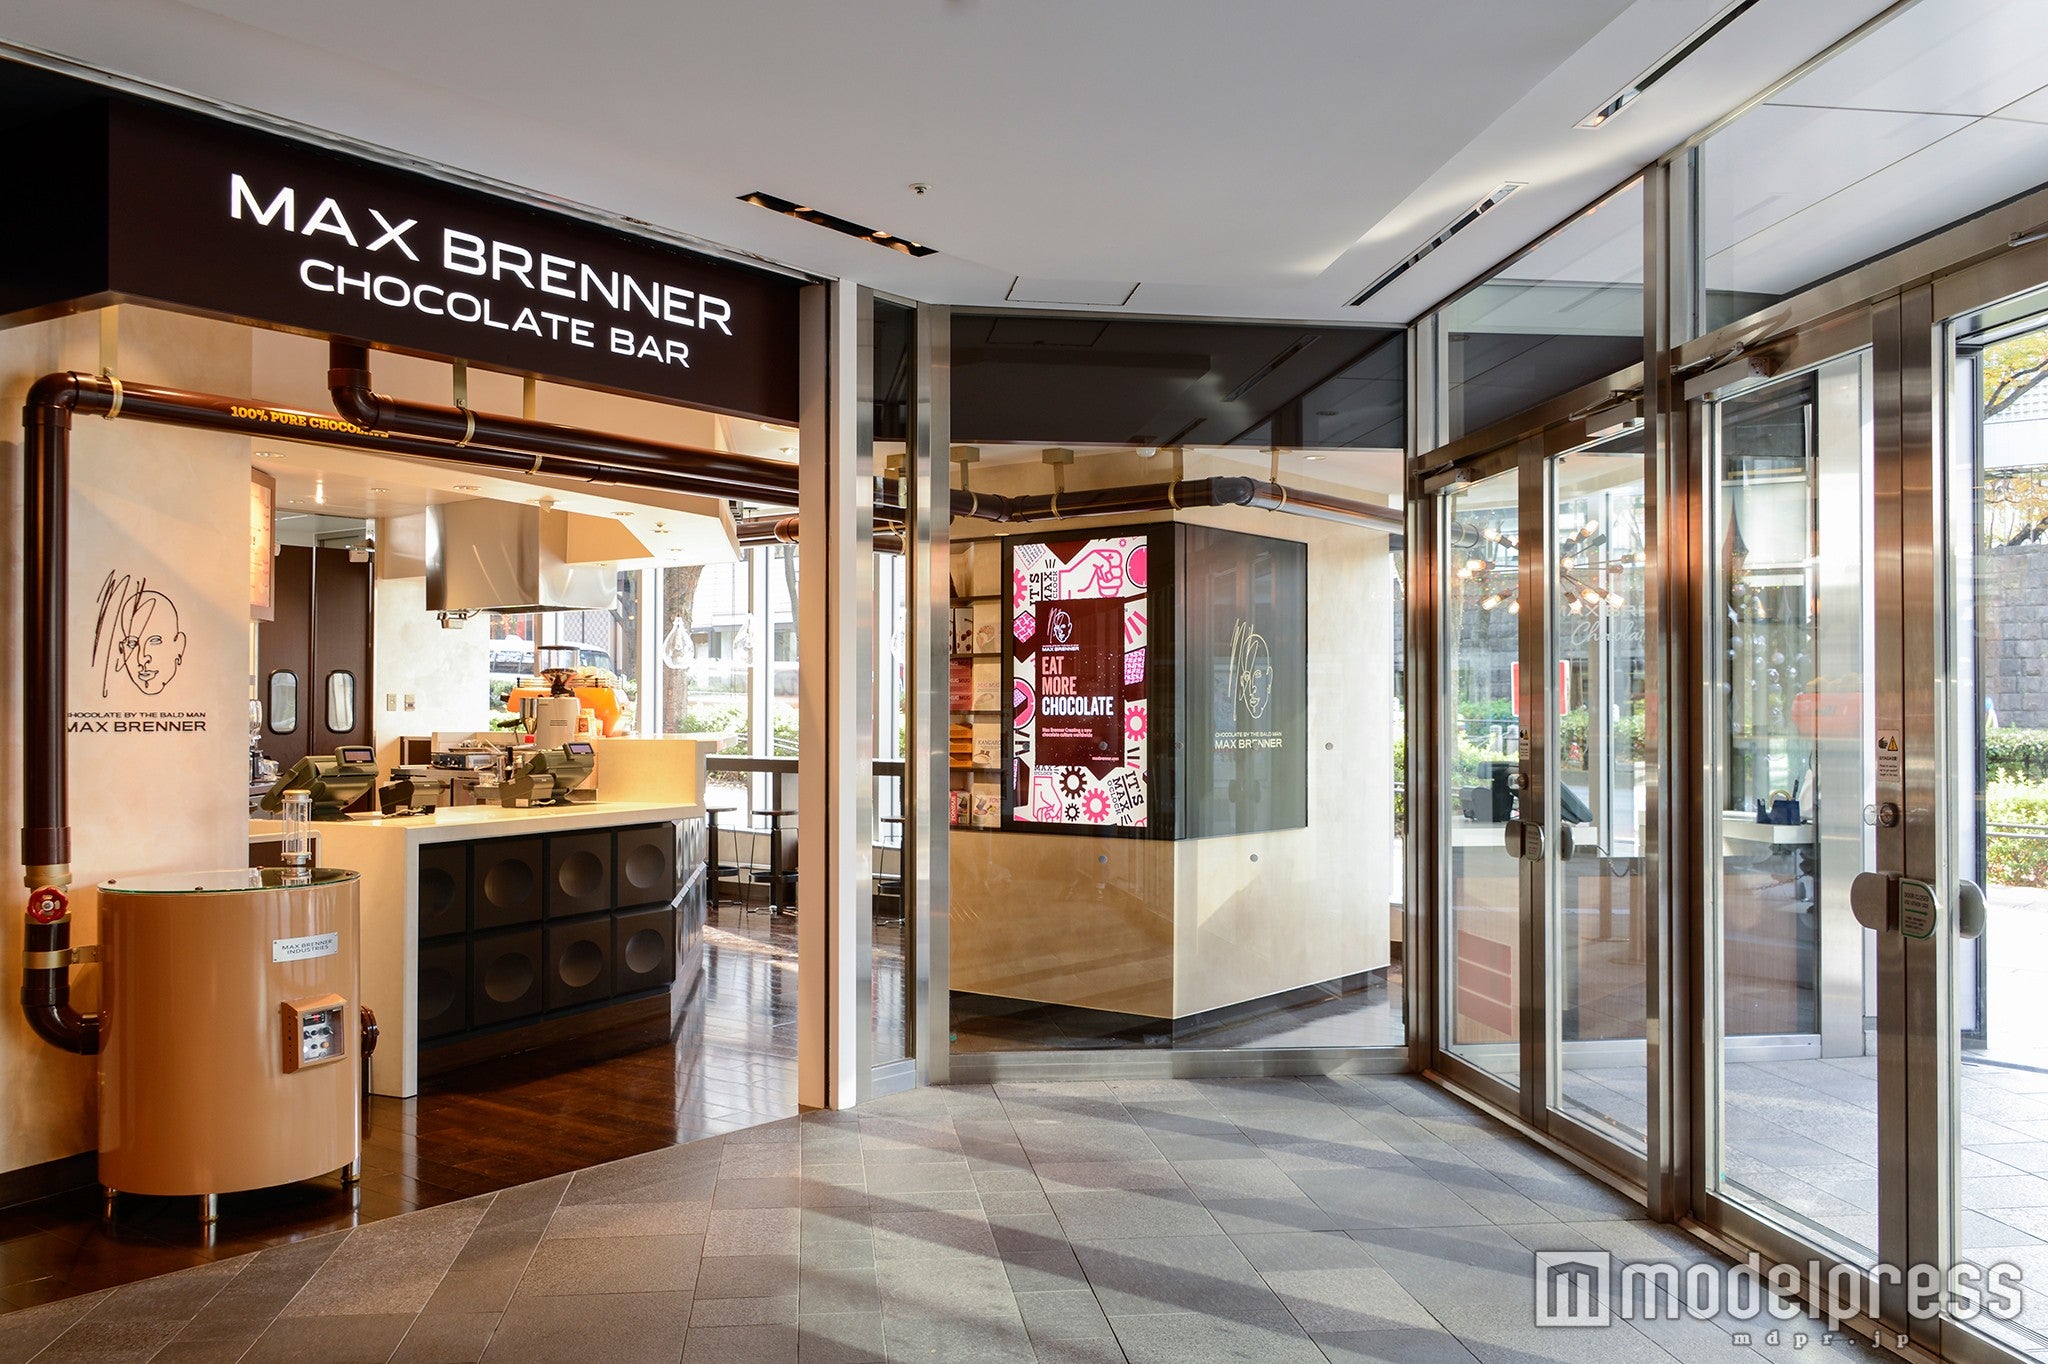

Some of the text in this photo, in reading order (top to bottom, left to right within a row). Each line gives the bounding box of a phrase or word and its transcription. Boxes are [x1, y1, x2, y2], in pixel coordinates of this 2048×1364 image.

[230, 173, 733, 336] MAX BRENNER
[300, 259, 690, 368] CHOCOLATE BAR
[230, 405, 389, 438] 100% PURE CHOCOL
[1029, 573, 1039, 607] IT'S
[1042, 656, 1065, 675] EAT
[1042, 676, 1077, 696] MORE
[1042, 696, 1114, 716] CHOCOLATE
[67, 721, 206, 733] MAX BRENNER
[1214, 739, 1237, 749] MAX
[1112, 775, 1130, 813] MAX
[1125, 771, 1145, 807] IT'S
[286, 944, 329, 955] INDUSTRIES
[301, 939, 333, 948] BRENNER
